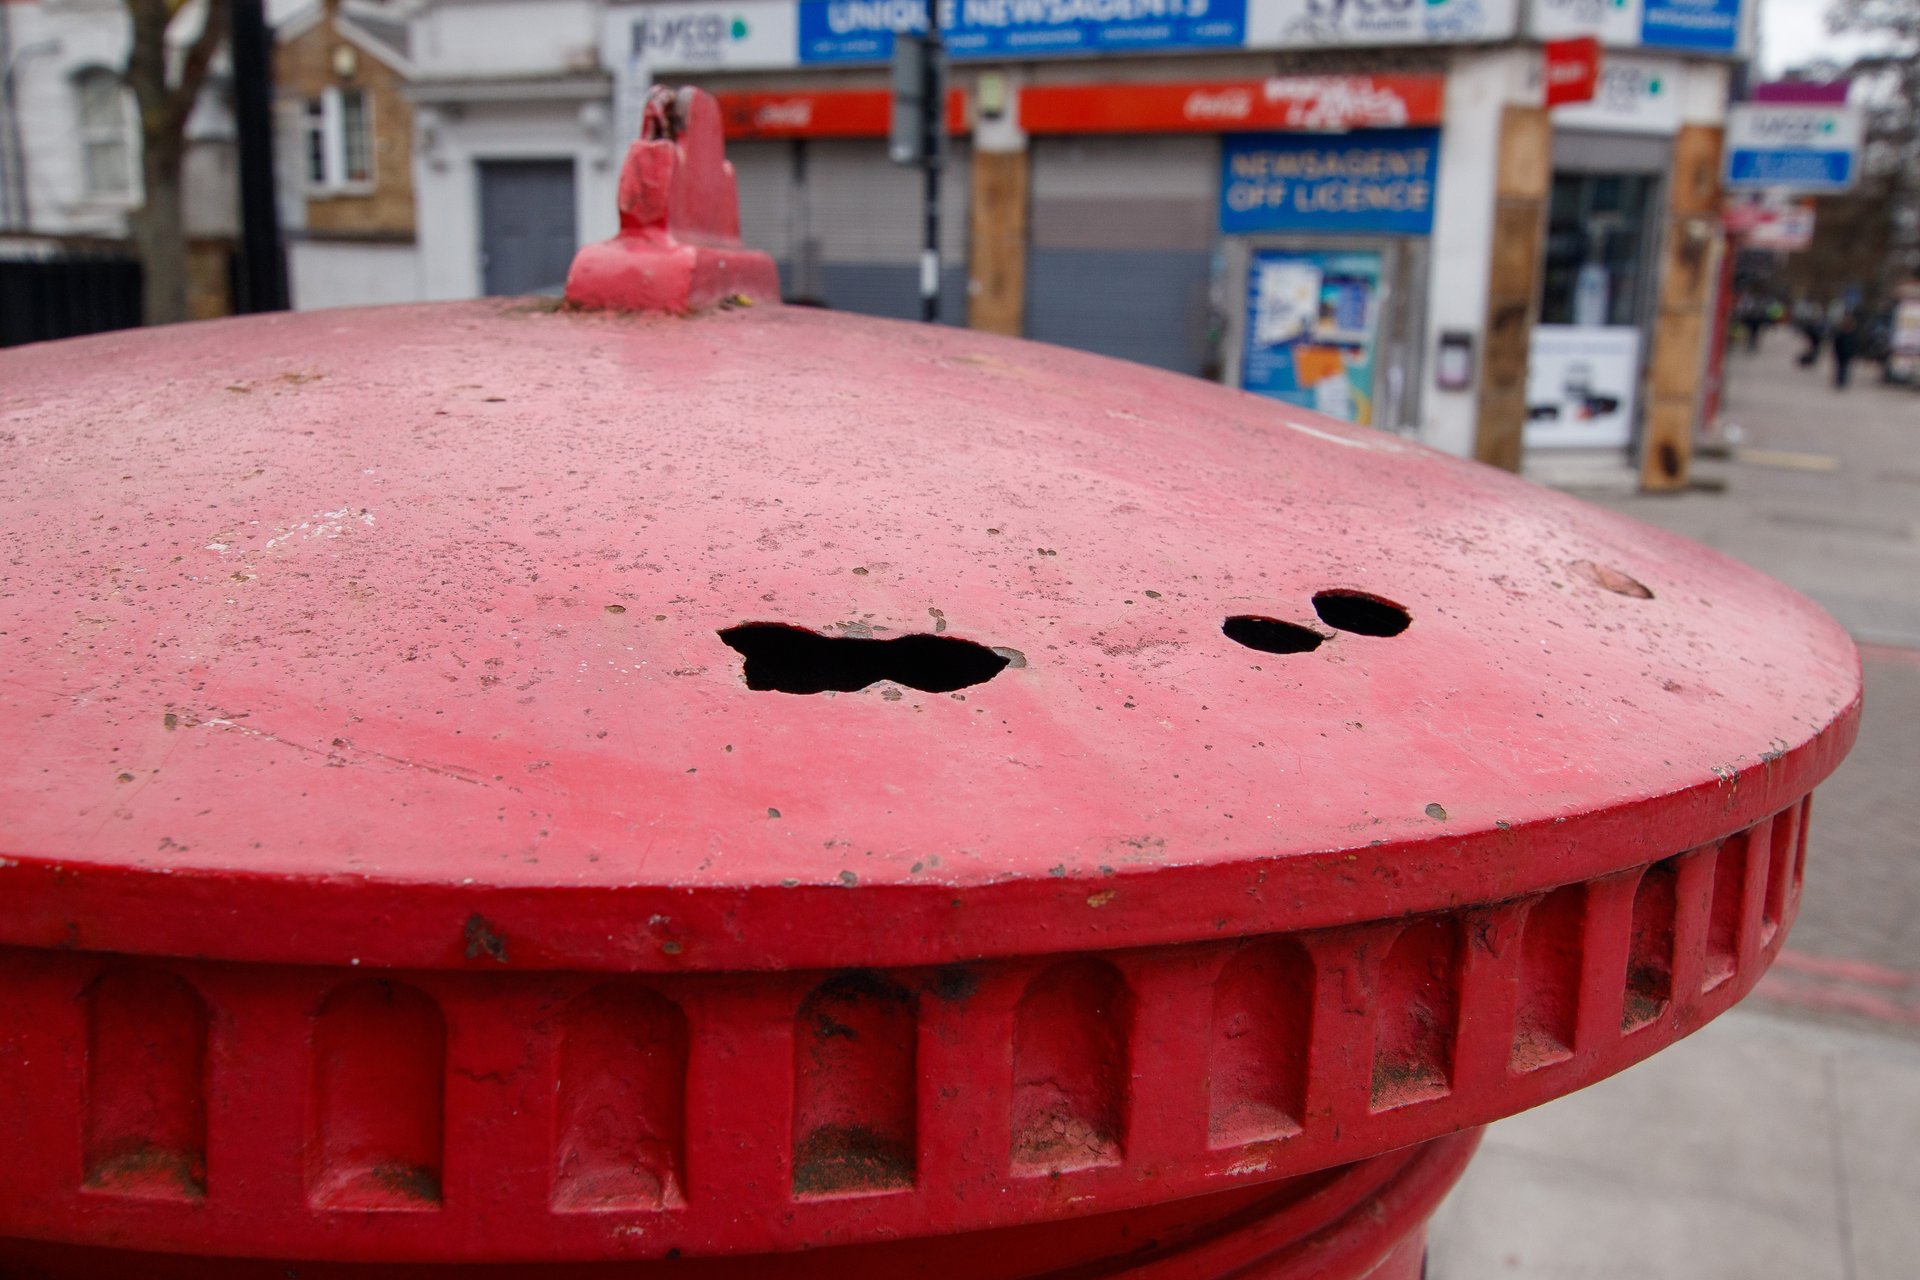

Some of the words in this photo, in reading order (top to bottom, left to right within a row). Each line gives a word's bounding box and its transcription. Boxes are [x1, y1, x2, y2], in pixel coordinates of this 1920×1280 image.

[1229, 148, 1428, 180] NEWSAGENT
[1227, 180, 1286, 212] OFF
[1294, 179, 1430, 212] LICENCE
